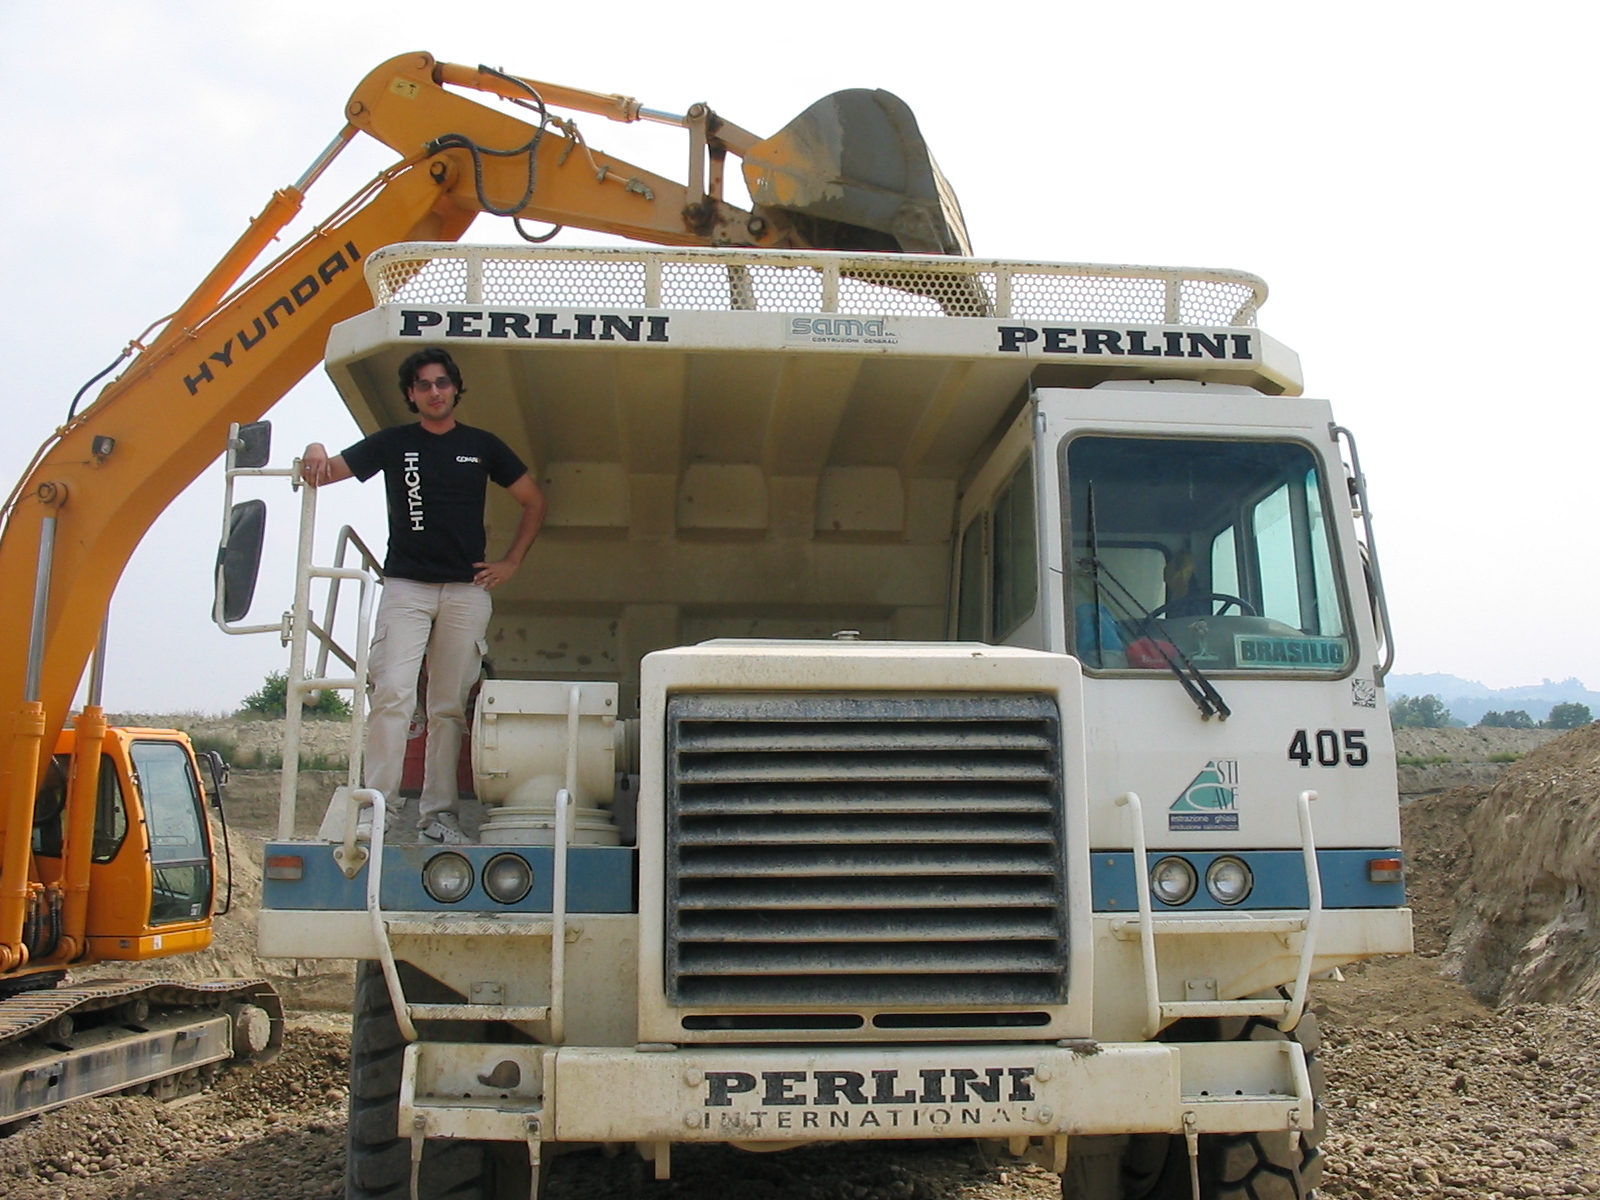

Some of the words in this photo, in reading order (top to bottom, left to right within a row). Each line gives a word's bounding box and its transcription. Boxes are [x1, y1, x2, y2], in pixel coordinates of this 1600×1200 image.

[183, 240, 362, 396] HYUNDAI
[399, 309, 670, 342] PERLINI
[997, 326, 1253, 360] PERLINI
[404, 451, 425, 531] HITACHI
[1241, 640, 1344, 664] BRASILIO
[1288, 729, 1368, 767] 405
[704, 1068, 1036, 1107] PERLINI
